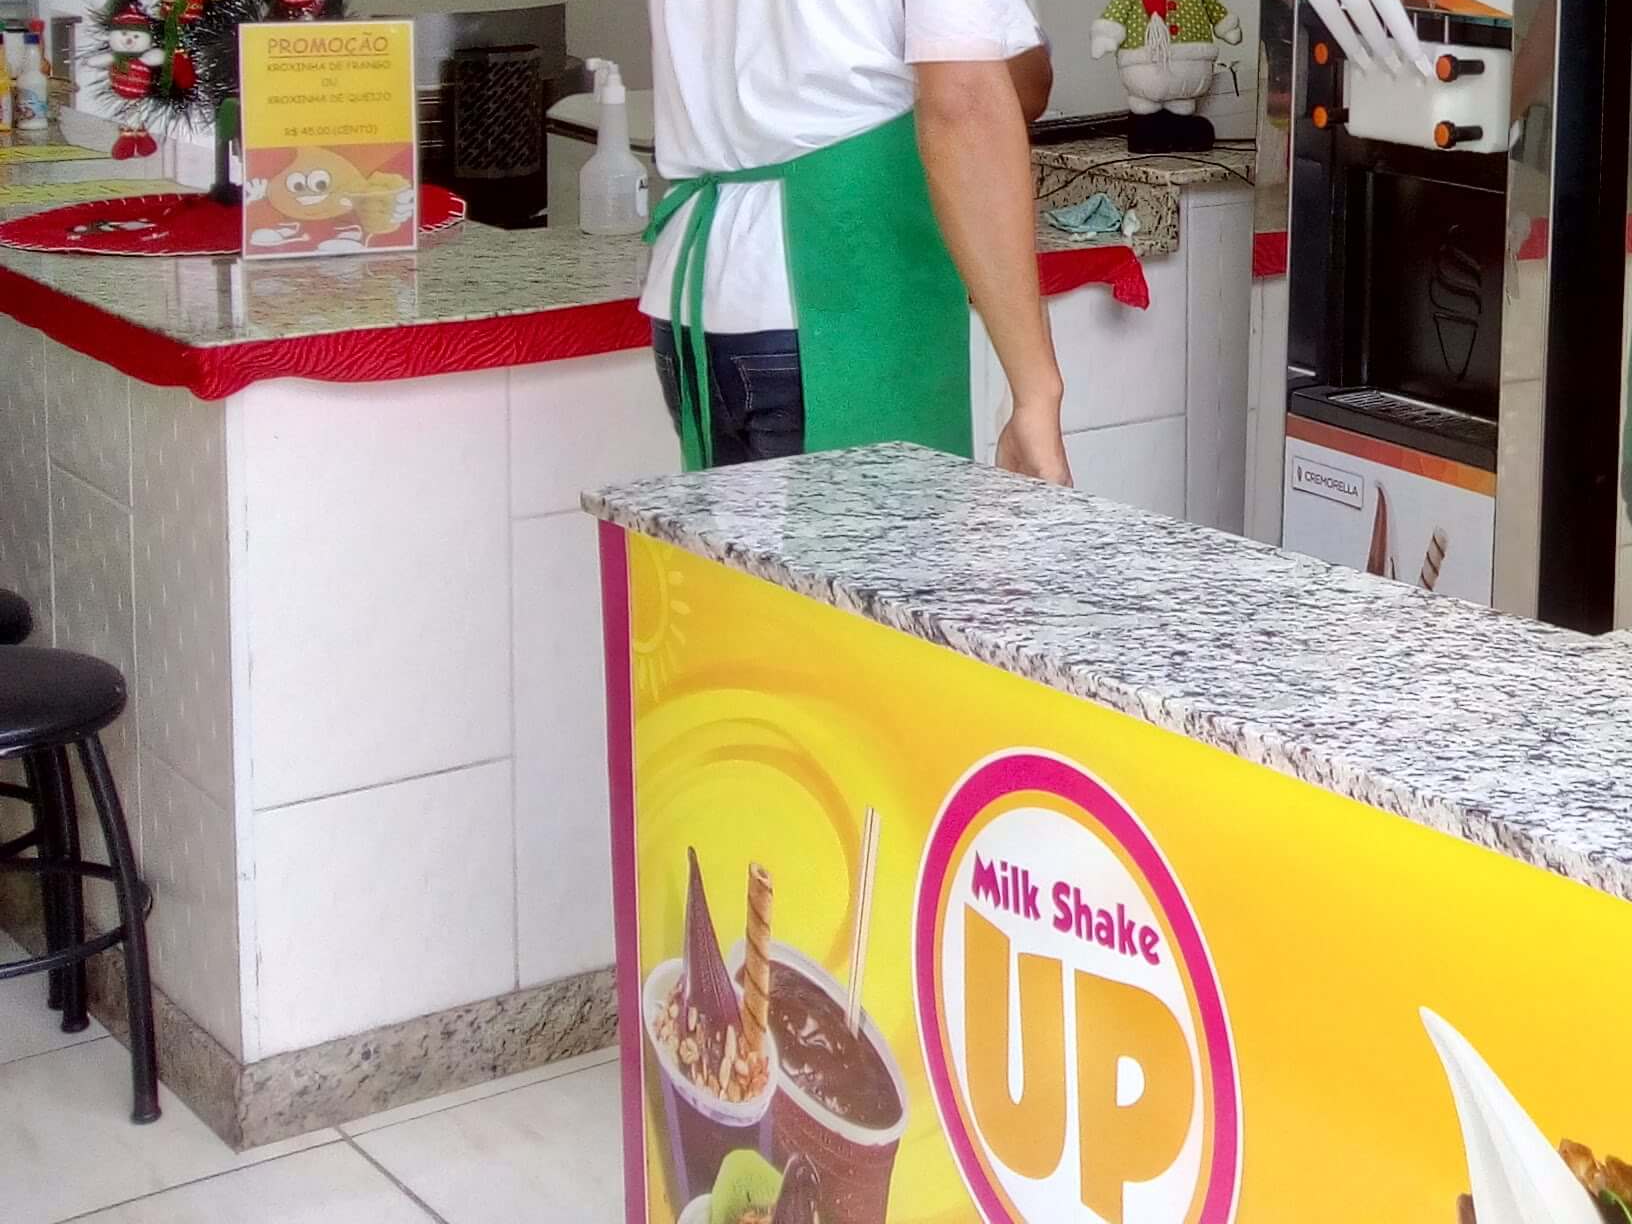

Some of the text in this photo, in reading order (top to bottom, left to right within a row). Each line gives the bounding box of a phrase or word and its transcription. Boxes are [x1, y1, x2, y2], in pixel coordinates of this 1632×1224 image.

[267, 31, 389, 55] PROMOÇÃO
[972, 849, 1161, 965] Milk Shake
[963, 902, 1196, 1224] UP
